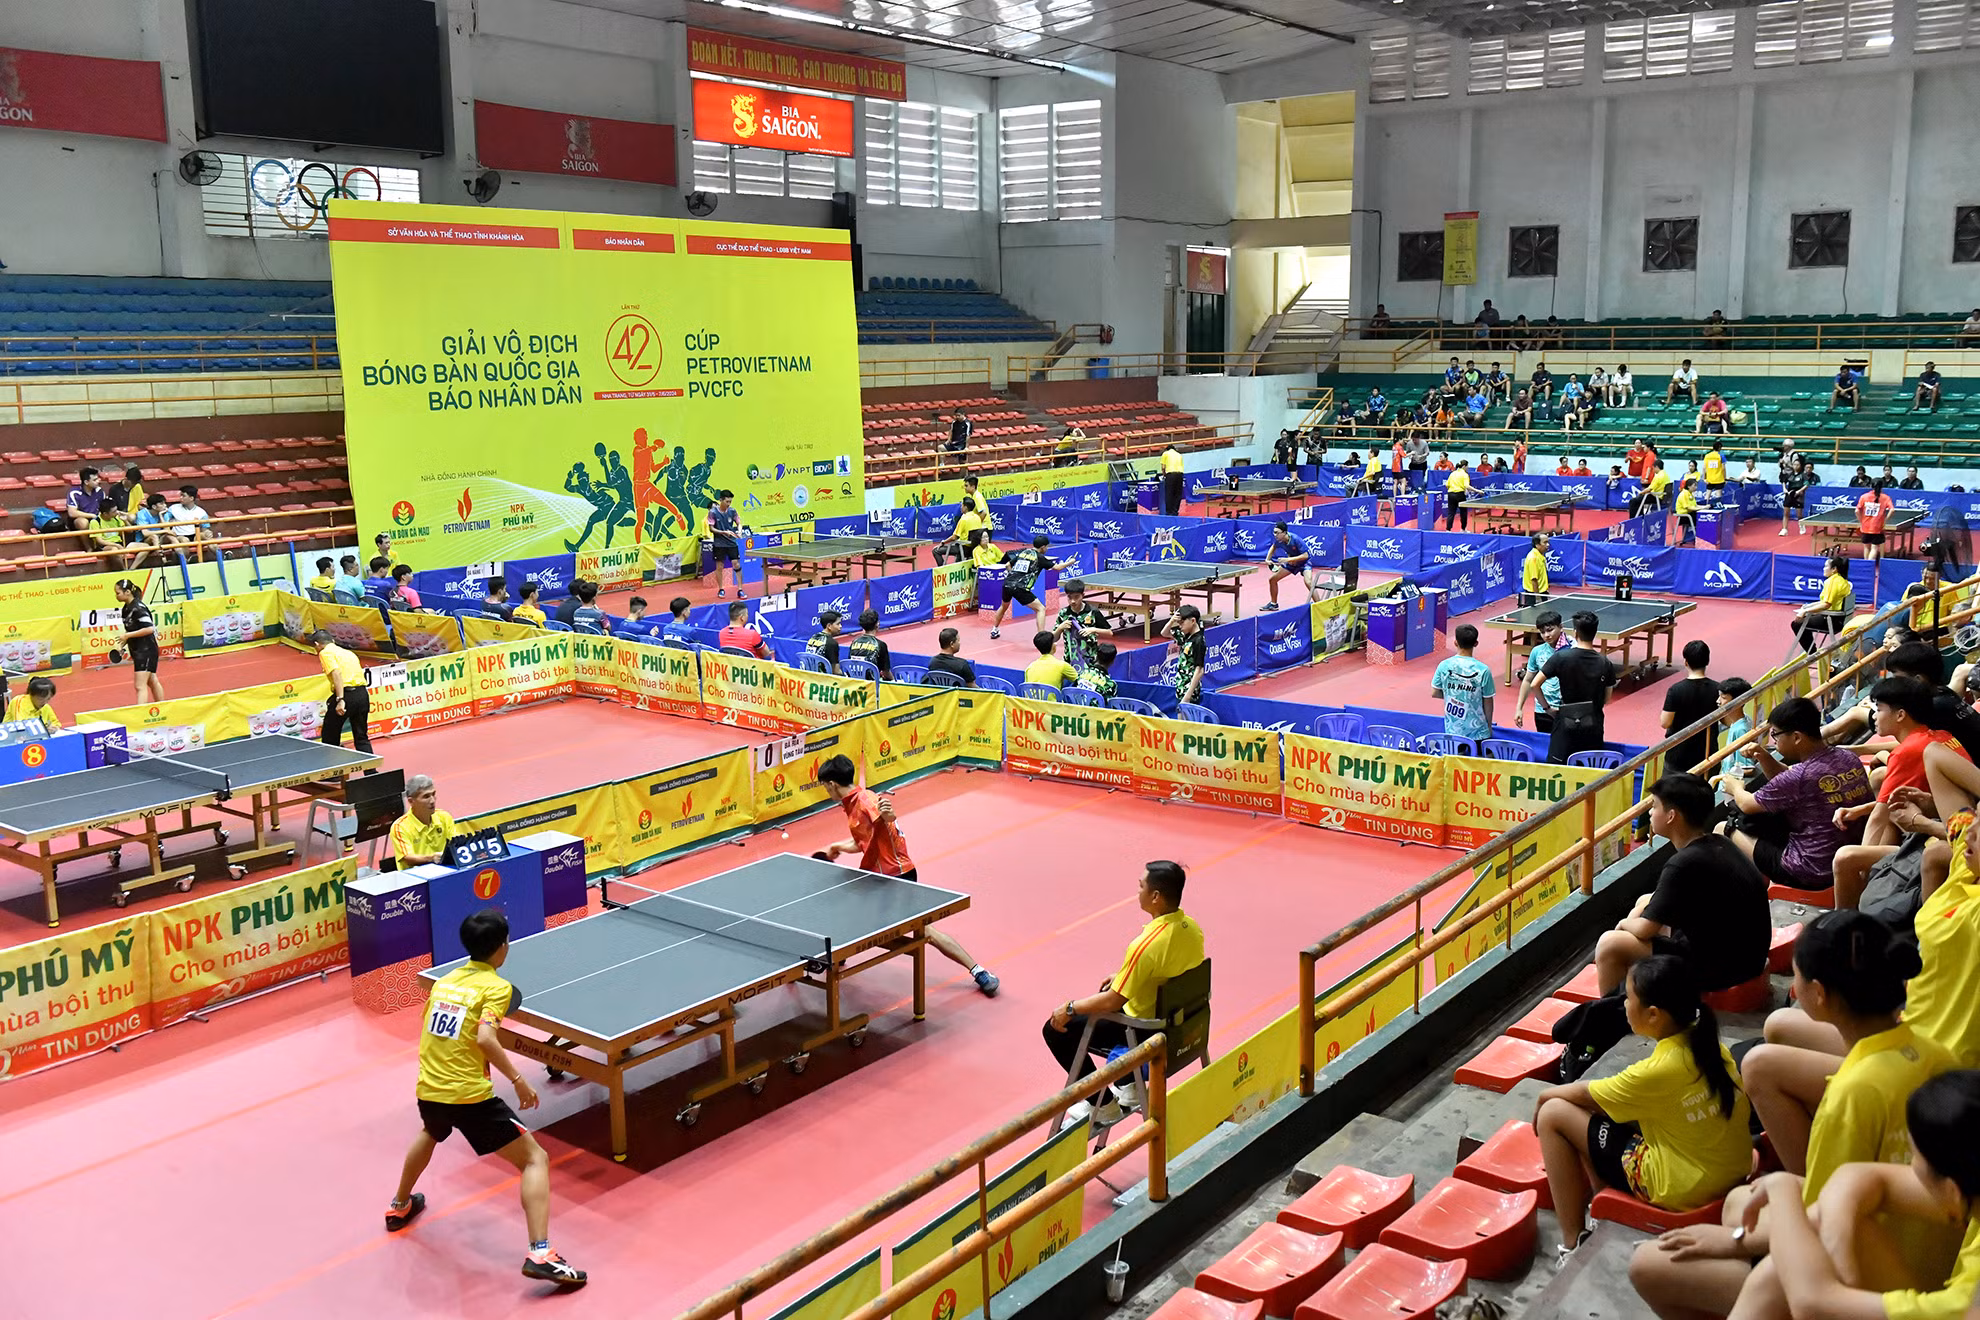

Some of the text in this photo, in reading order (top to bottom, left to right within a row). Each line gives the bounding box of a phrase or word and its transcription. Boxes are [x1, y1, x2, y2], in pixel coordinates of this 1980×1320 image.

[692, 39, 718, 63] ĐOÀN
[743, 50, 773, 73] TRUNG
[775, 55, 801, 81] THỰC,
[803, 60, 821, 81] CAO
[823, 62, 857, 88] THƯỢNG
[858, 64, 869, 87] VÀ
[871, 66, 889, 90] TIẾN
[891, 70, 903, 97] BỘ
[782, 105, 800, 119] BIA
[562, 159, 599, 172] SAIGON
[387, 228, 398, 237] SỞ
[399, 228, 414, 237] VĂN
[414, 229, 429, 238] HÓA
[429, 229, 439, 238] VÀ
[440, 228, 453, 238] THỂ
[489, 232, 511, 241] KHÁNH
[511, 234, 525, 242] HÒA
[605, 237, 645, 247] BÁO NHÂN DÂN
[442, 328, 578, 358] GIẢI VÔ ĐỊCH
[612, 323, 653, 370] 42
[684, 328, 720, 351] CÚP
[362, 352, 581, 386] BÓNG BÀN QUỐC GIA
[686, 355, 812, 375] PETROVIETNAM
[428, 380, 583, 411] BÁO NHÂN DÂN
[688, 380, 744, 399] PVCFC
[421, 469, 498, 482] NHÀ ĐỒNG HÀNH CHÍNH
[786, 466, 811, 475] VNPT
[987, 487, 1015, 498] VÔ ĐỊCH
[1052, 480, 1066, 490] CÚP
[443, 519, 491, 534] PETROVIETNAM
[746, 538, 753, 548] 6
[1361, 549, 1404, 560] DOUBLE FISH
[9, 590, 23, 600] THỂ
[71, 585, 86, 594] VIỆT
[89, 609, 98, 625] 0
[884, 599, 920, 615] DOUBLE FISH
[477, 637, 569, 674] NPK PHÚ MỸ
[617, 648, 690, 678] NPK PHÚ MỸ
[1204, 655, 1241, 674] DOUBLE FISH
[480, 664, 569, 690] Cho mùa bội thu
[503, 682, 573, 706] 20 TIN DÙNG
[391, 703, 471, 735] 20 TIN DÙNG
[1446, 702, 1465, 718] 009
[1011, 707, 1127, 743] NPK PHÚ MỸ
[27, 745, 40, 766] 8
[764, 744, 773, 767] 0
[1014, 734, 1128, 763] Cho mùa bội thu
[1139, 727, 1269, 763] NPK PHÚ MỸ
[350, 765, 363, 773] 235
[1142, 755, 1269, 785] Cho mùa bội thu
[1290, 745, 1432, 791] NPK PHÚ MỸ
[658, 783, 669, 792] NHÀ
[681, 776, 694, 786] HÀNH
[1292, 776, 1431, 813] Cho mùa bội thu
[1453, 768, 1566, 803] NPK PHÚ
[139, 800, 196, 820] MOFIT
[506, 809, 568, 831] NHÀ ĐỒNG HÀNH CHÍNH
[671, 812, 705, 830] PETROVIETNAM
[1319, 807, 1346, 830] 20
[1363, 819, 1388, 834] TIN
[1390, 821, 1434, 840] DÙNG
[479, 872, 494, 897] 7
[162, 869, 347, 956] NPK PHÚ MỸ
[169, 917, 348, 984] Cho mùa bội thu
[204, 946, 350, 1007] 20 TIN DÙNG
[727, 974, 787, 1007] MOFIT
[430, 1011, 457, 1037] 164
[41, 1033, 80, 1059] TIN
[85, 1013, 142, 1047] DÙNG
[514, 1038, 573, 1067] DOUBLE FISH
[1047, 1218, 1063, 1240] NPK
[1038, 1227, 1070, 1265] PHÚ MỸ
